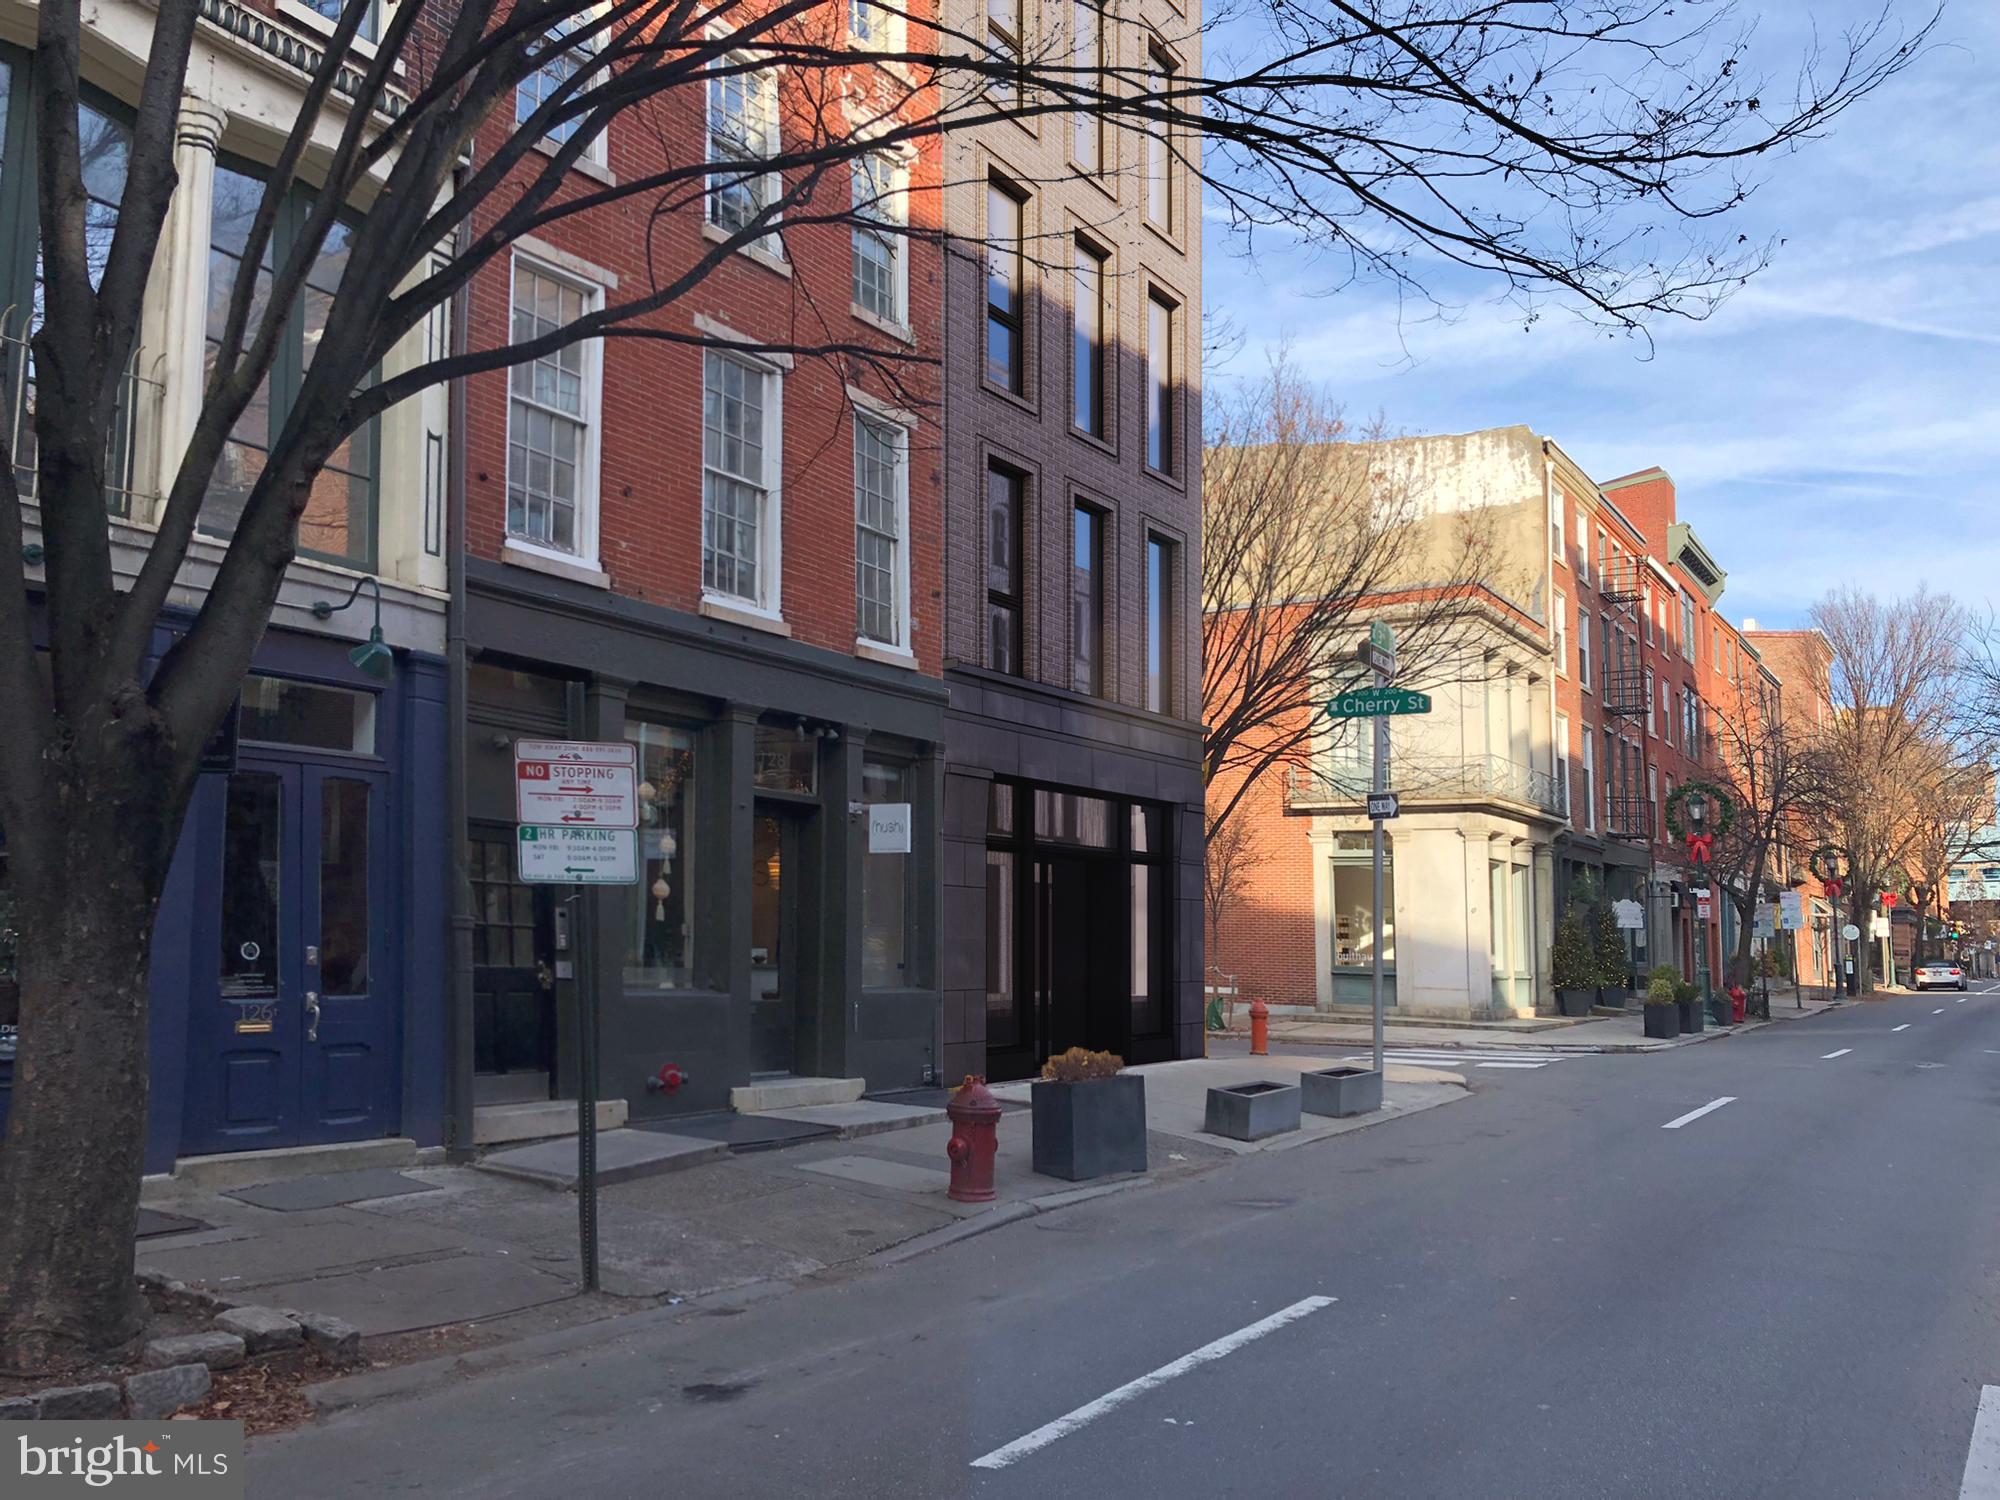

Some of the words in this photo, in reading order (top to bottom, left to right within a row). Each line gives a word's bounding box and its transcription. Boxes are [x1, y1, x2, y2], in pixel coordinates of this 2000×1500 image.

[1372, 689, 1380, 697] W
[1343, 698, 1400, 716] Cherry
[1407, 696, 1425, 710] St
[526, 765, 545, 777] NO
[553, 766, 615, 780] STOPPING
[1370, 800, 1380, 812] ONE
[1381, 800, 1391, 812] WAY
[525, 828, 532, 840] 2
[539, 828, 556, 840] HR
[561, 829, 616, 842] PARKING
